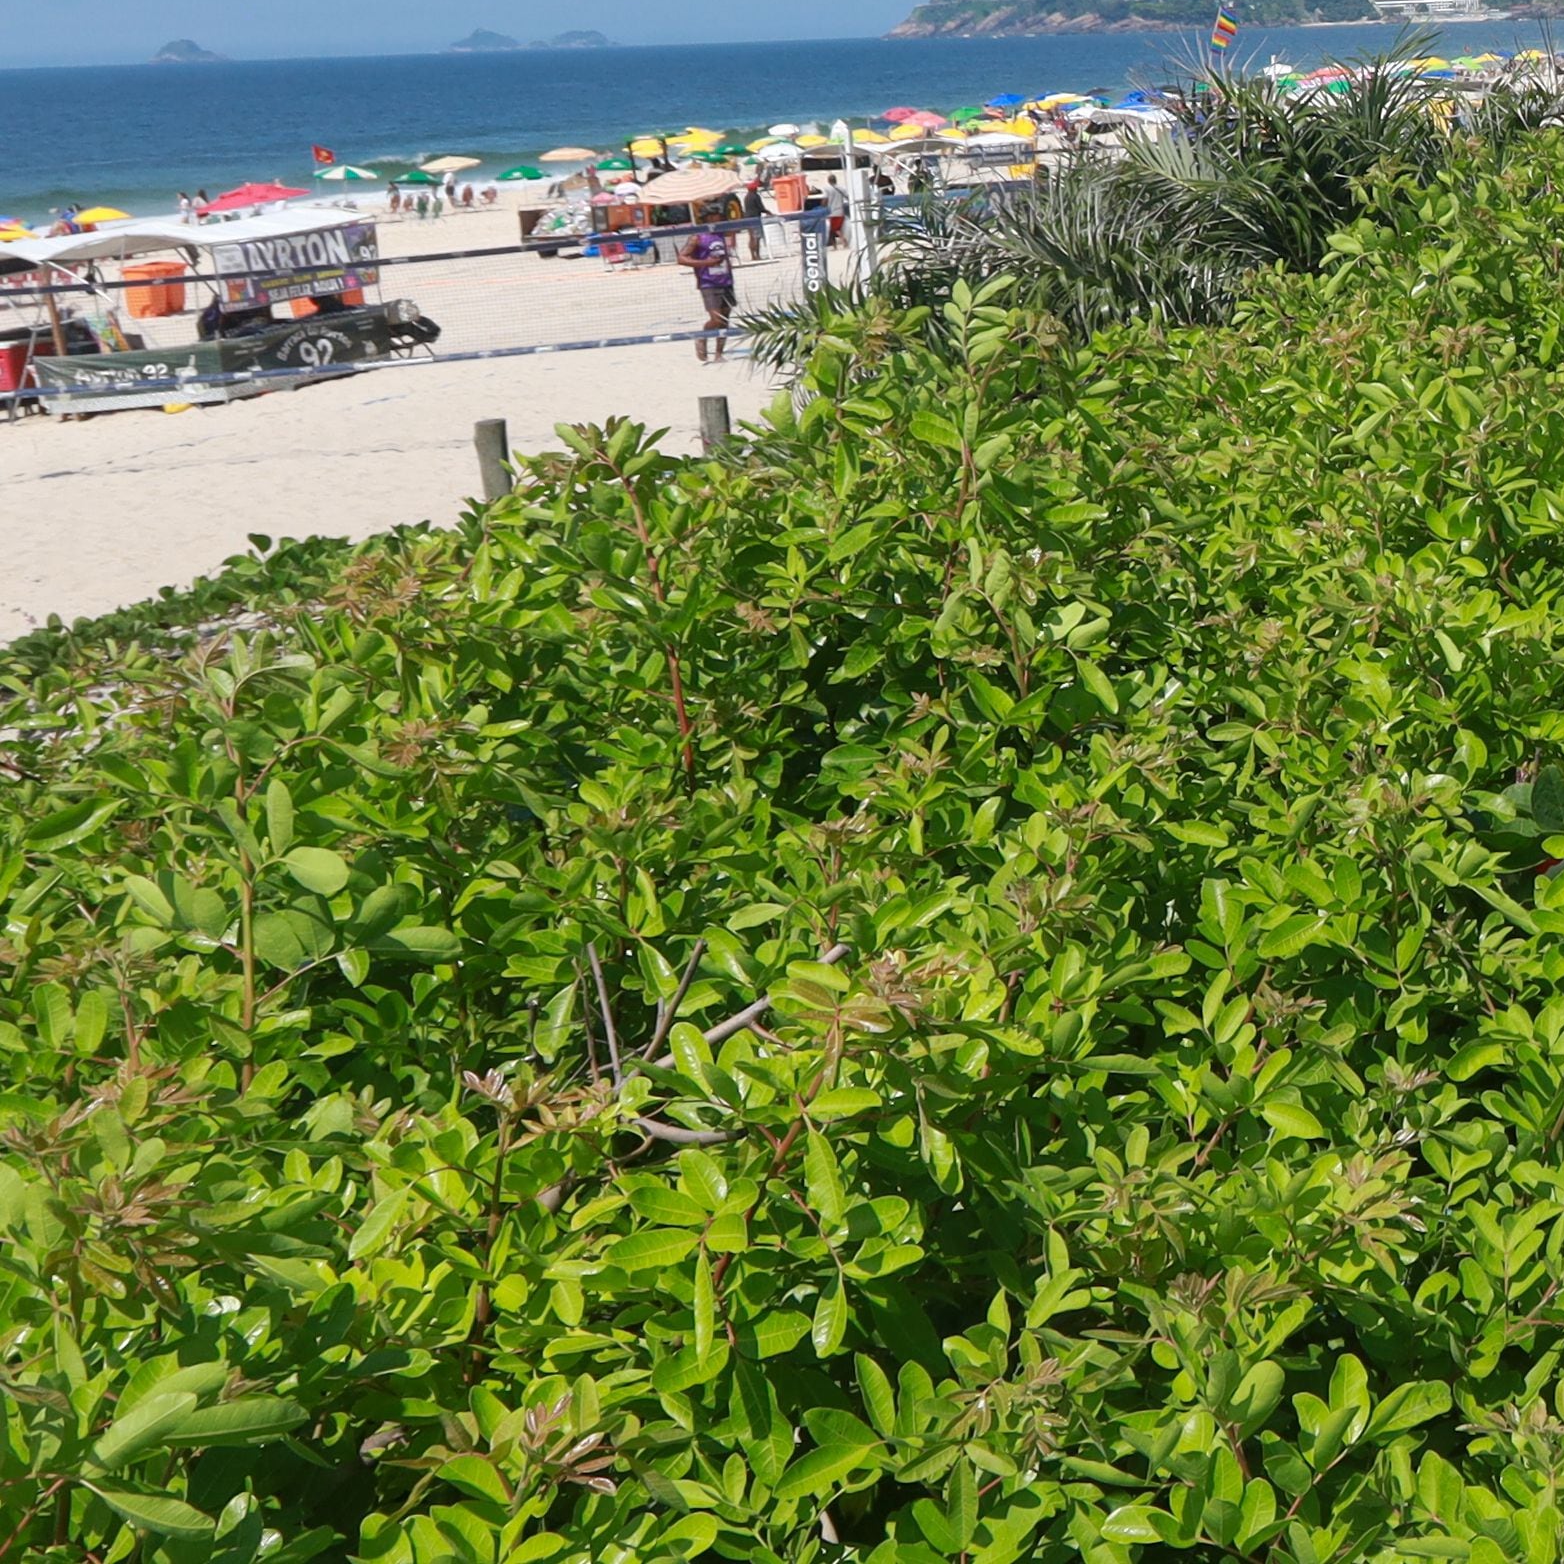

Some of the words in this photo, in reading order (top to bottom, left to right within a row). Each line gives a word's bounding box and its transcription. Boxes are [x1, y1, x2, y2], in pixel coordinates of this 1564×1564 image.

[246, 229, 350, 272] AYRTON
[299, 338, 333, 367] 92
[142, 363, 169, 380] 92
